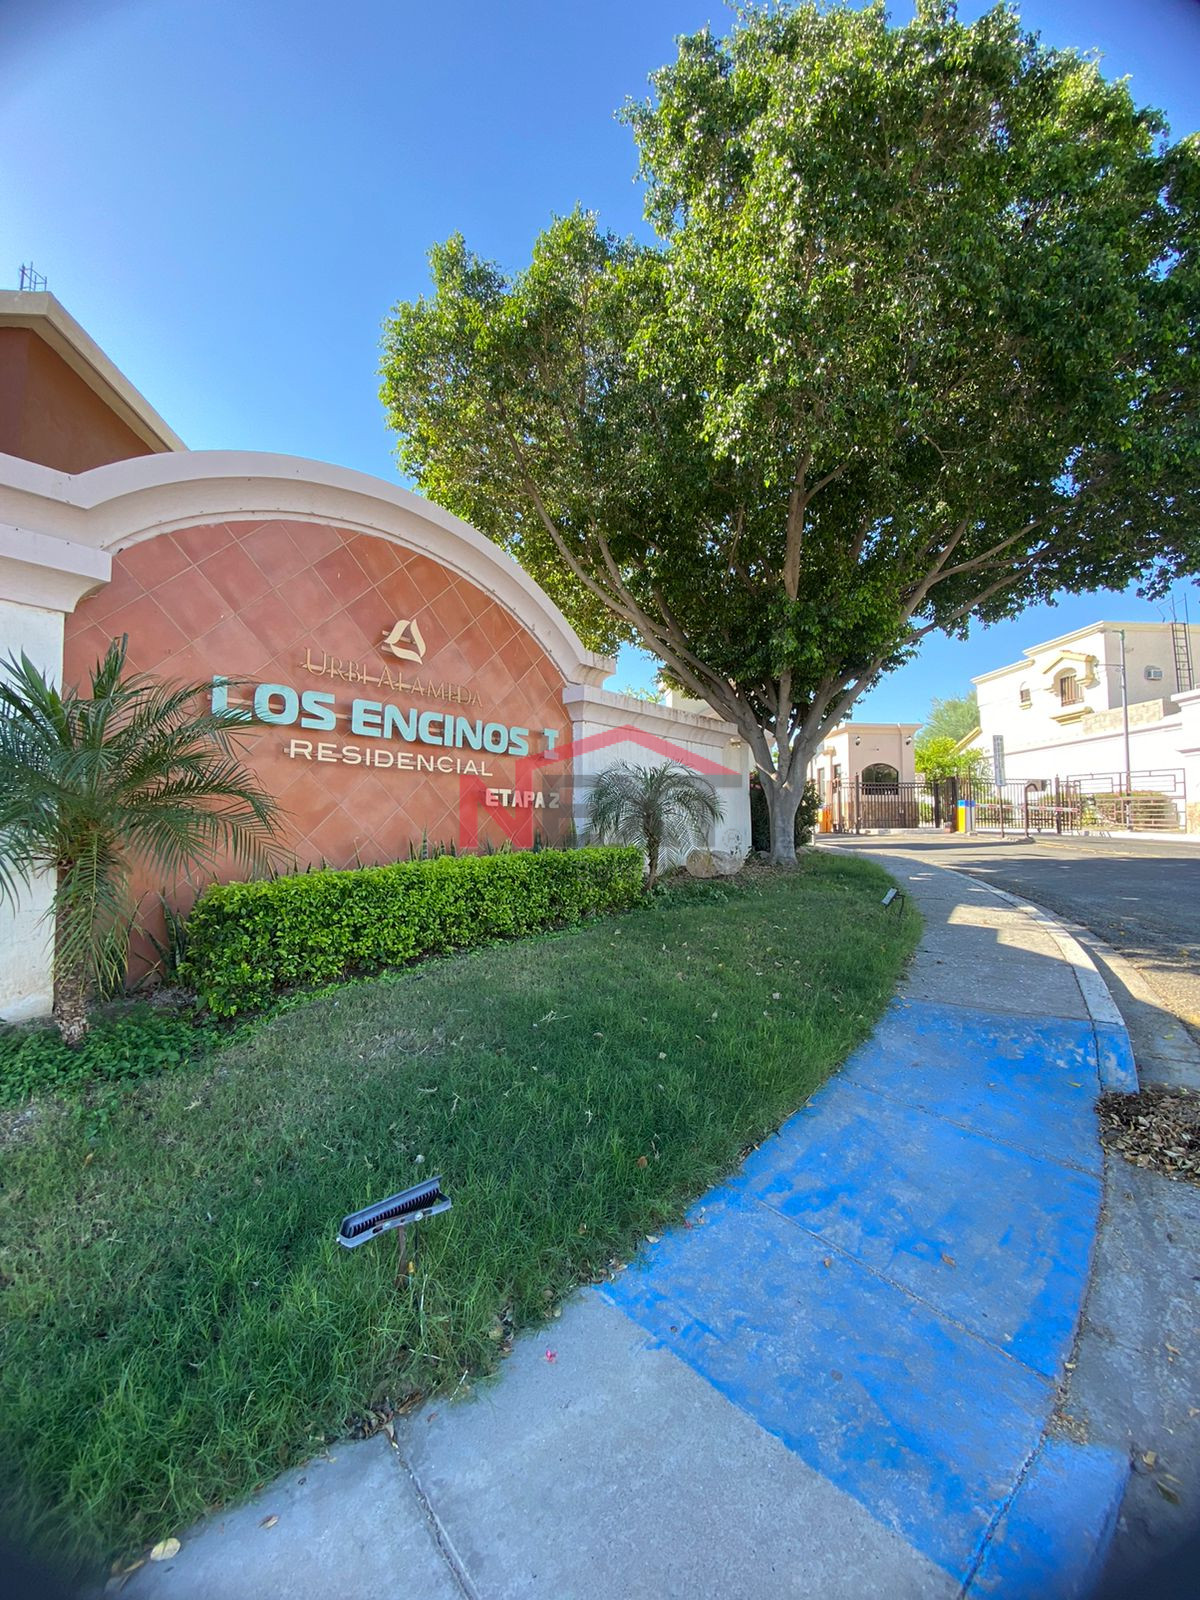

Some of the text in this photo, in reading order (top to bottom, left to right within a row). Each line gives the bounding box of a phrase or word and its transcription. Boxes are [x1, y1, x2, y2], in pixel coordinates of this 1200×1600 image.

[304, 648, 482, 708] URBI ALAMEDA
[211, 674, 560, 759] LOS ENCINOS I
[289, 739, 494, 777] RESIDENCIAL
[485, 787, 560, 809] ETAPA 2
